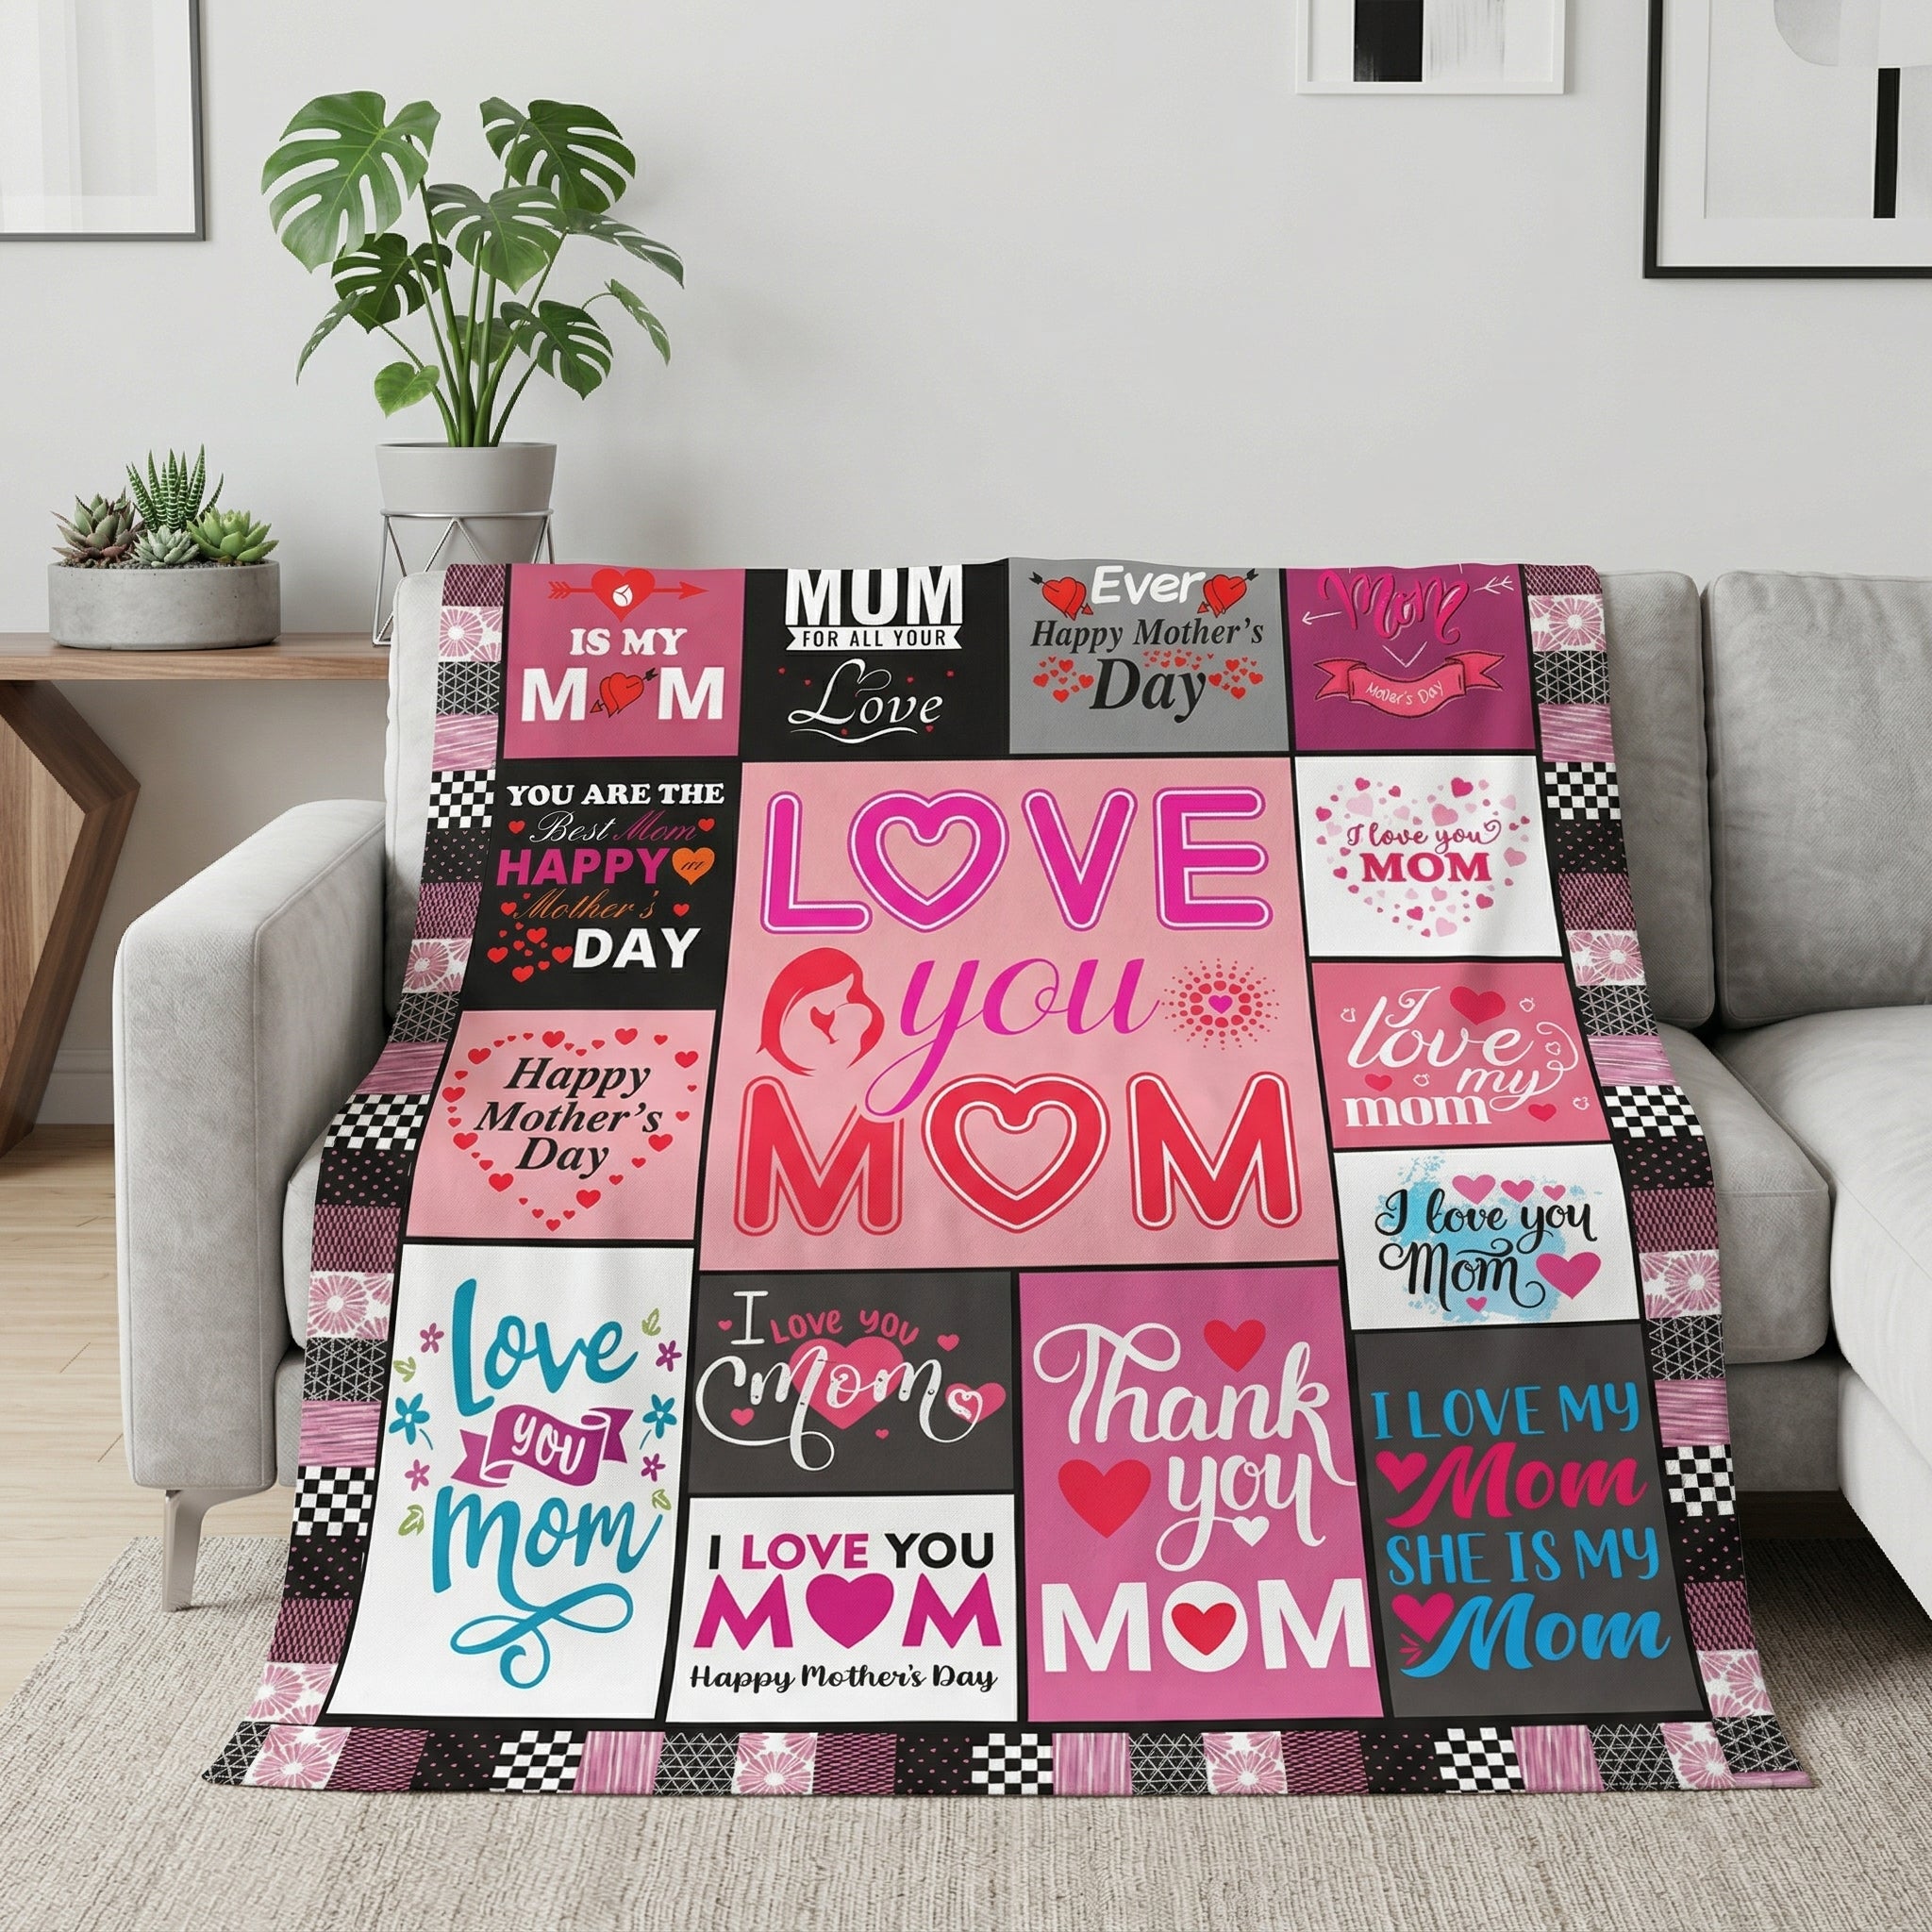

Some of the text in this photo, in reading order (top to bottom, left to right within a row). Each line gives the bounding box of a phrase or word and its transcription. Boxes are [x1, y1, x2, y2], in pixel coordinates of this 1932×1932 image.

[1091, 565, 1206, 605] Ever
[569, 627, 688, 656] IS MY
[803, 629, 946, 646] FOR ALL YOUR
[1030, 618, 1264, 654] Happy Mother's
[788, 658, 943, 725] Love
[1089, 658, 1208, 724] Day
[1417, 680, 1443, 704] Day
[506, 783, 724, 806] YOU ARE THE
[529, 809, 698, 842] Best Mom
[1347, 819, 1502, 855] I love you
[496, 847, 671, 886] HAPPY
[760, 787, 1274, 934] LOVE
[1359, 852, 1493, 883] MOM
[512, 888, 660, 920] Mother's
[573, 927, 702, 969] DAY
[1384, 986, 1441, 1028] I
[865, 958, 1159, 1117] you
[503, 1057, 651, 1099] Happy
[473, 1101, 663, 1133] Mother's
[1342, 1095, 1492, 1127] mom
[515, 1137, 609, 1179] Day
[733, 1072, 1303, 1237] MOM
[1374, 1188, 1598, 1255] I love you
[1378, 1238, 1546, 1312] Mom
[730, 1290, 769, 1345] I
[452, 1277, 639, 1416] Love
[695, 1345, 983, 1472] Mom
[1033, 1322, 1357, 1487] Thank
[1370, 1381, 1641, 1440] I LOVE MY
[1385, 1441, 1649, 1528] Mom
[1156, 1453, 1327, 1573] you
[708, 1532, 994, 1570] I LOVE YOU
[1386, 1526, 1660, 1586] SHE IS MY
[1041, 1577, 1372, 1674] MOM
[1400, 1592, 1672, 1678] Mom
[690, 1664, 998, 1693] Happy Mother's Day
